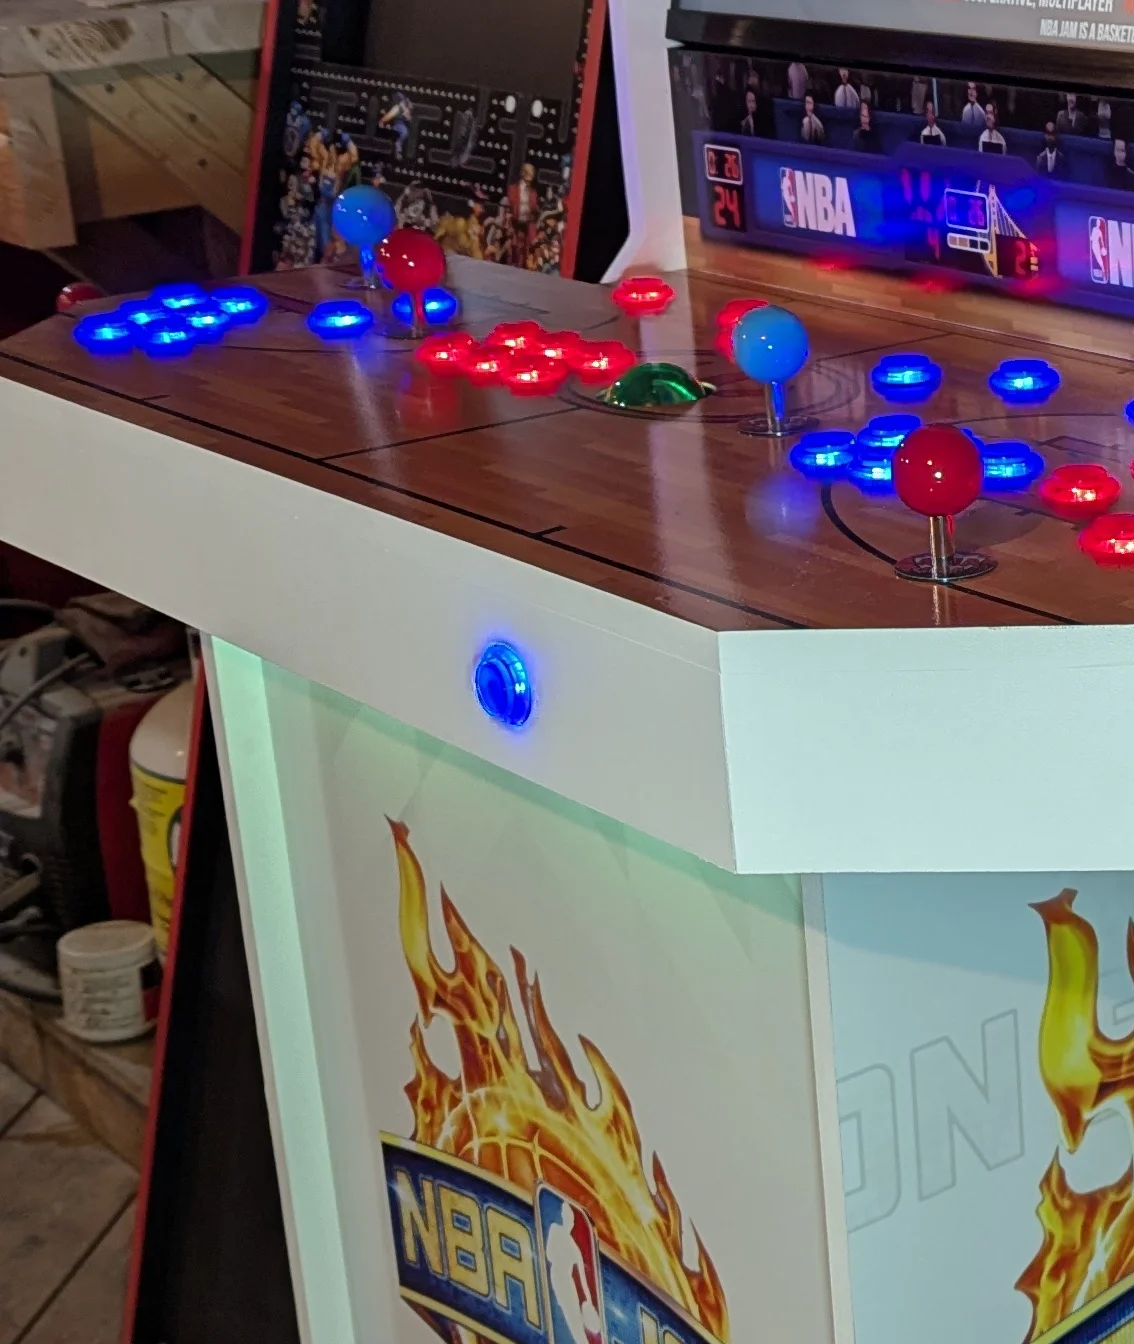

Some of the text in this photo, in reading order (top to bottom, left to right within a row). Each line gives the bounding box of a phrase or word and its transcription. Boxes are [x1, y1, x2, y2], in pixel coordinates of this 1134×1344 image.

[1039, 18, 1058, 37] NBA
[1058, 20, 1078, 39] JAM
[1079, 22, 1088, 40] IS
[1088, 22, 1097, 40] A
[713, 184, 741, 229] 24
[794, 169, 857, 238] NBA
[397, 1168, 543, 1332] NBA
